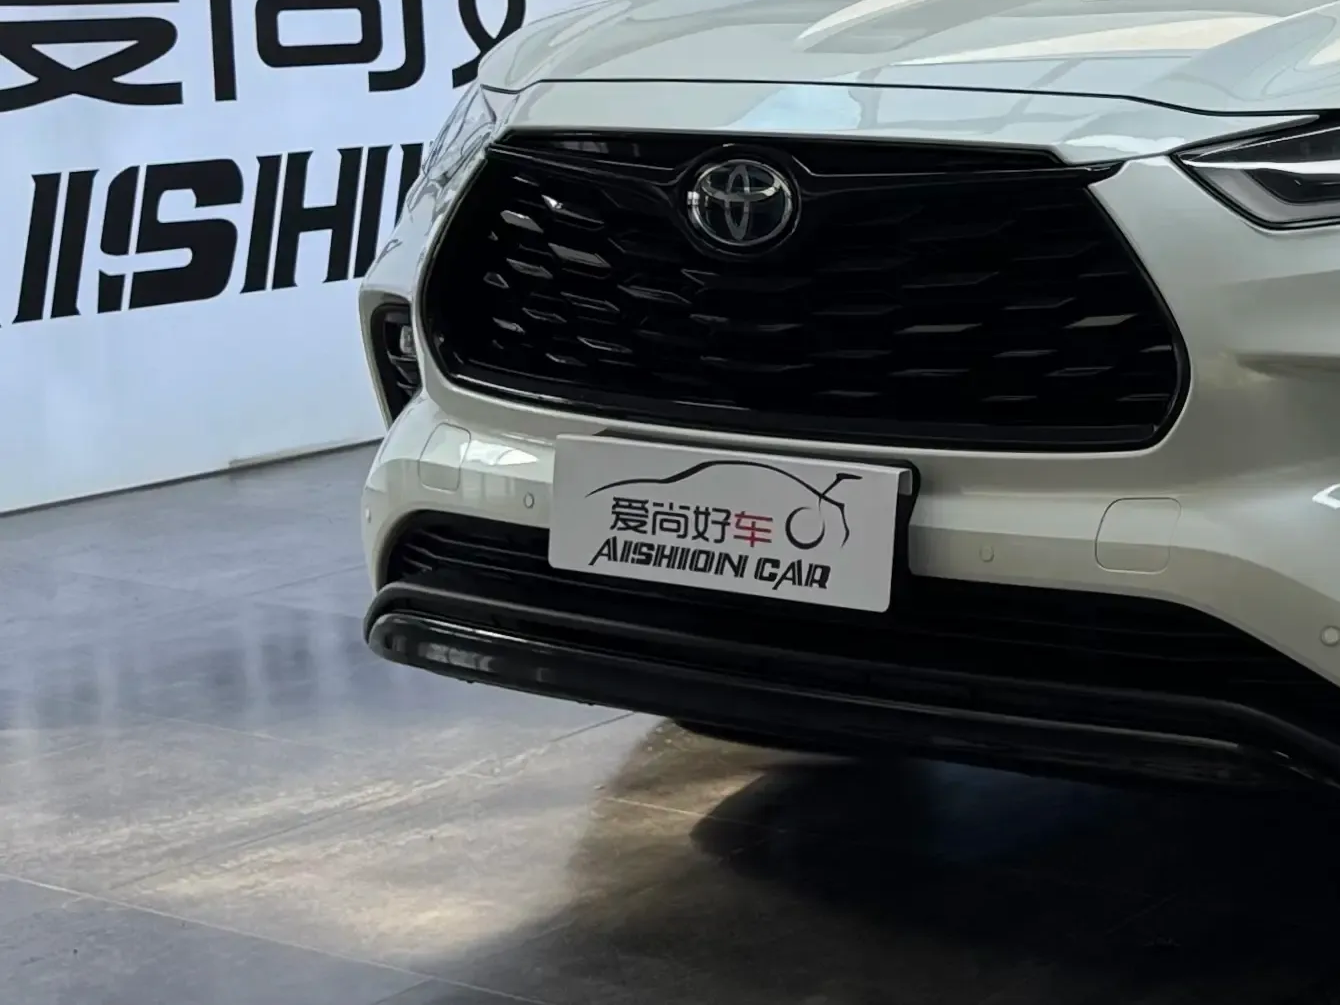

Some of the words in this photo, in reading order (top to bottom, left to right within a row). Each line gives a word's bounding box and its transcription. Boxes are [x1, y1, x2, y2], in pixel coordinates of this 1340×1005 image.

[609, 496, 773, 547] 爱尚好车
[588, 535, 750, 579] AISHION
[754, 557, 831, 590] CAR
